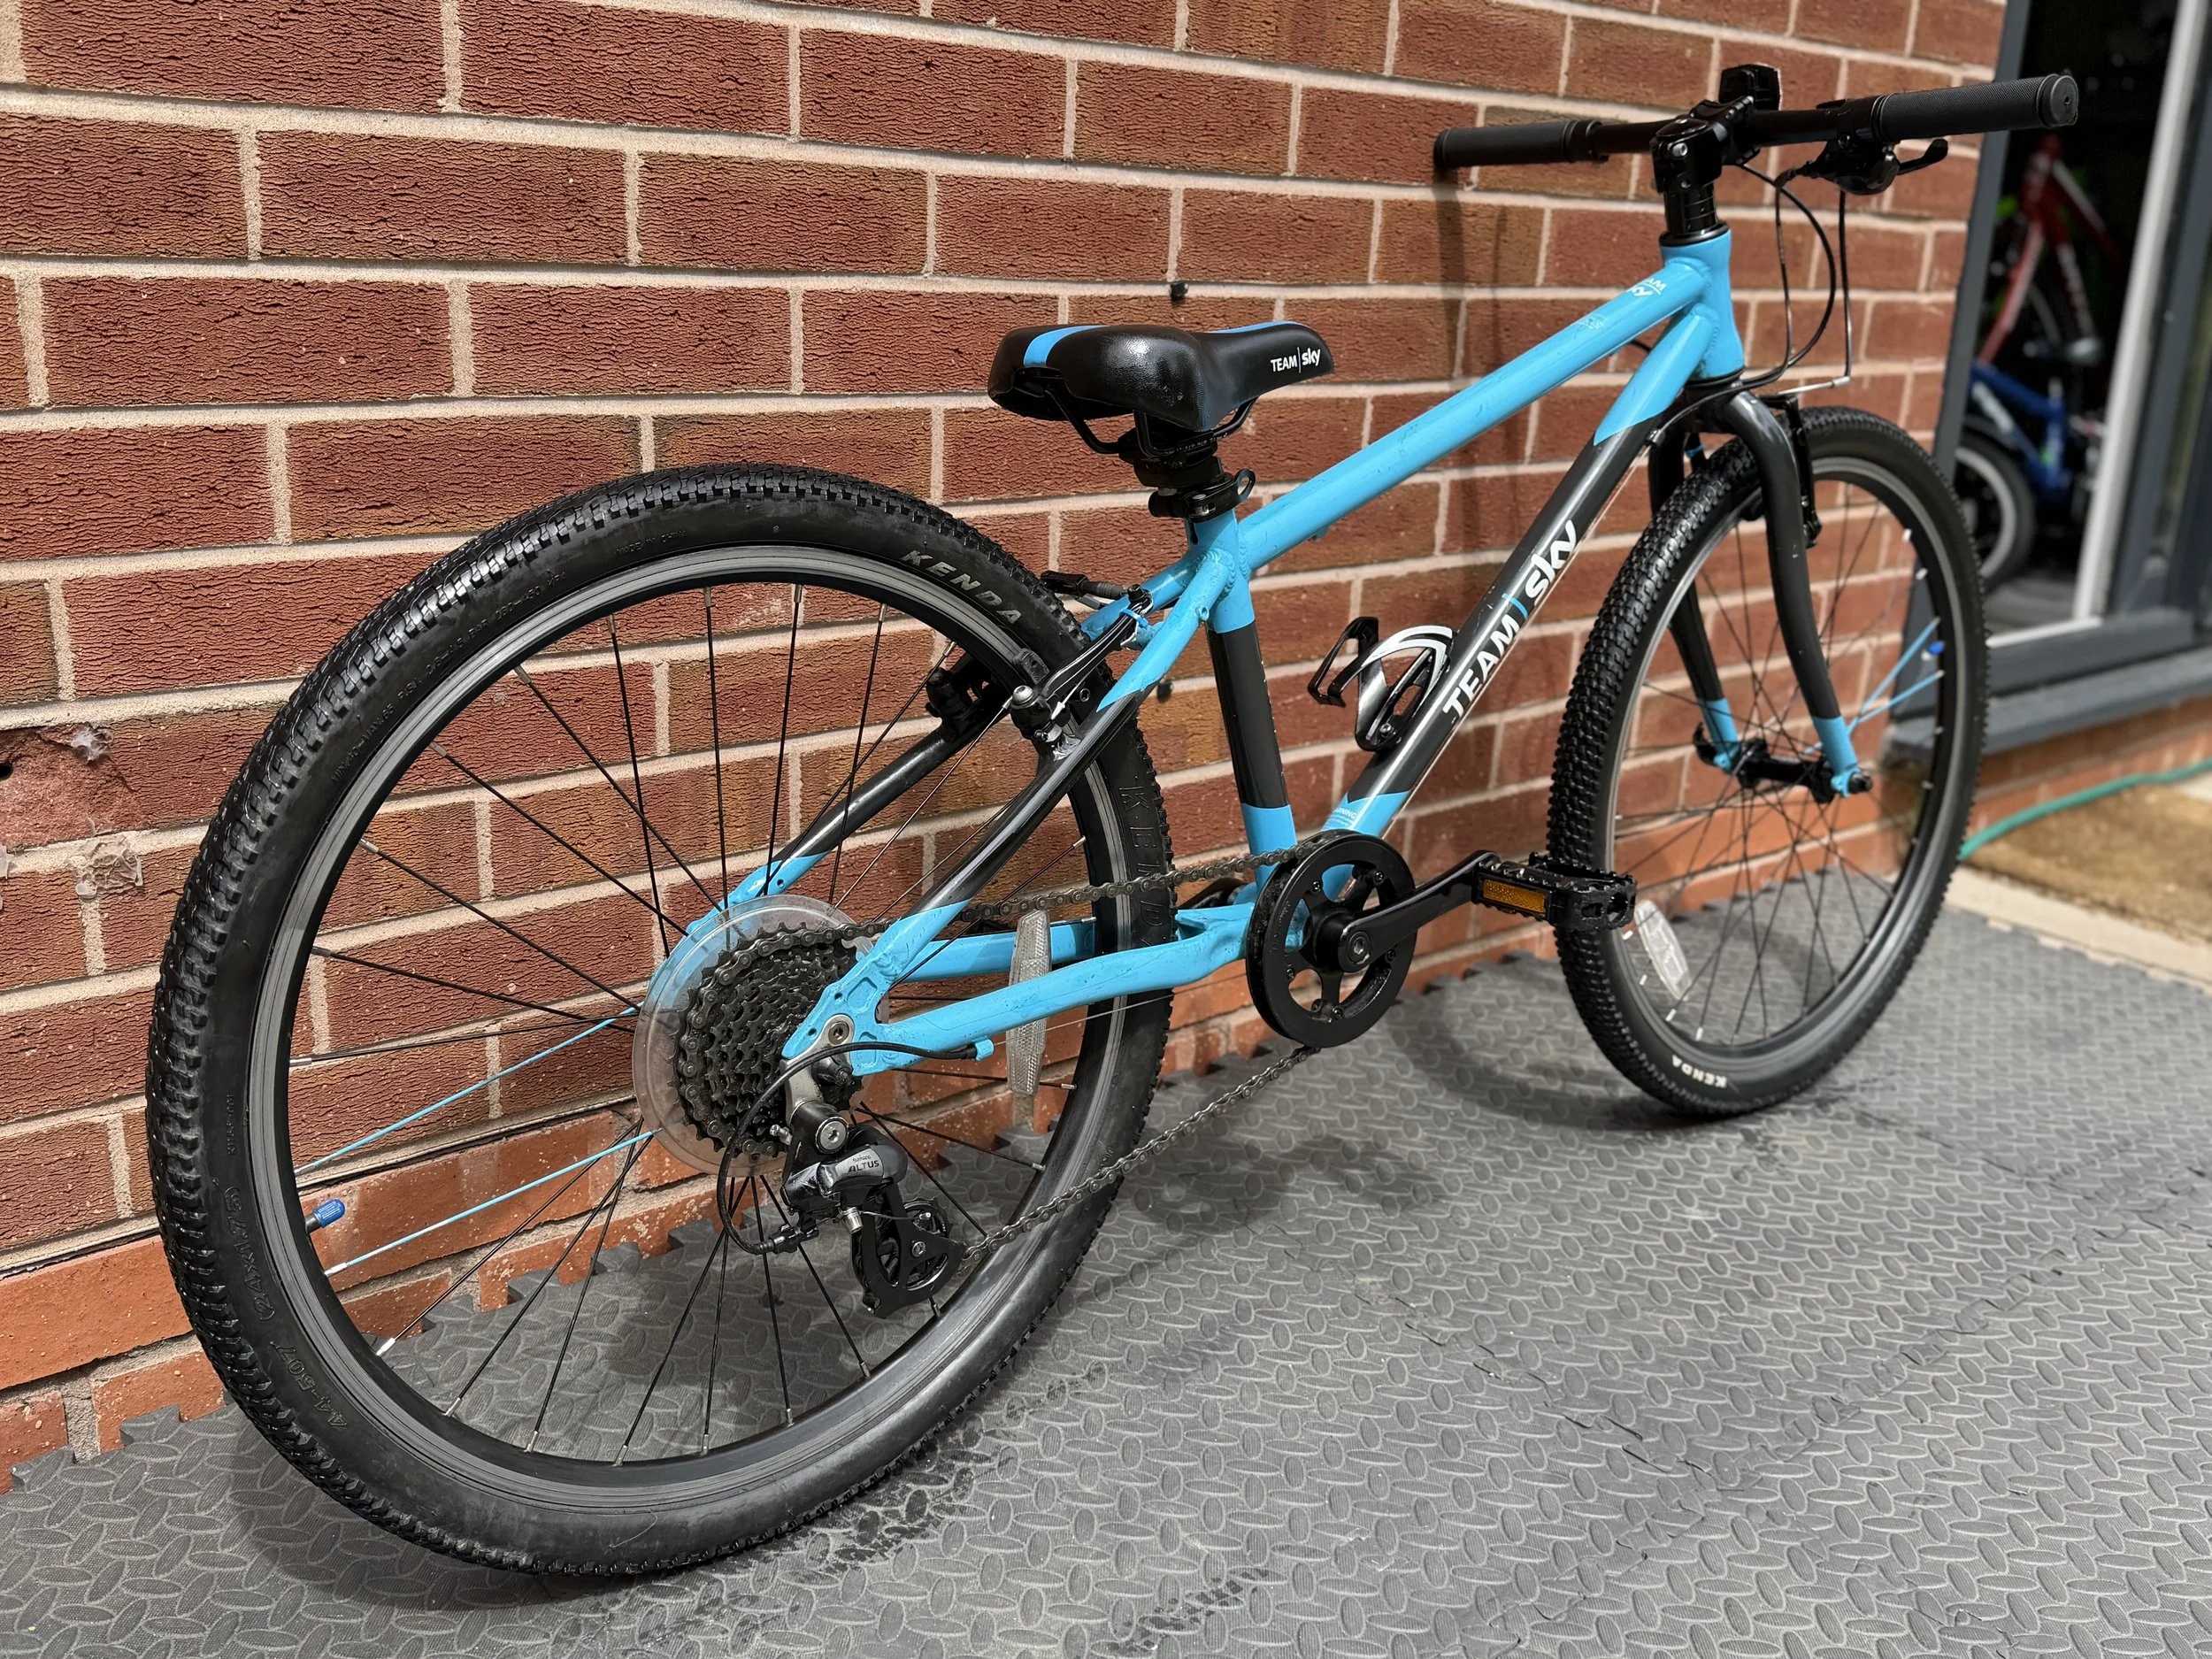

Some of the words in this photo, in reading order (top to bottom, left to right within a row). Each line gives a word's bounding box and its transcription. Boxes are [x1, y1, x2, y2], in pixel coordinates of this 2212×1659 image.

[1271, 355, 1297, 372] TEAM
[1302, 347, 1321, 366] sky
[900, 549, 1022, 624] KENDA
[1442, 614, 1521, 718] TEAM
[1118, 786, 1166, 946] KEND
[1671, 1054, 1728, 1088] KENDA
[848, 1160, 879, 1173] ALTUS
[275, 1344, 349, 1431] 44-507
